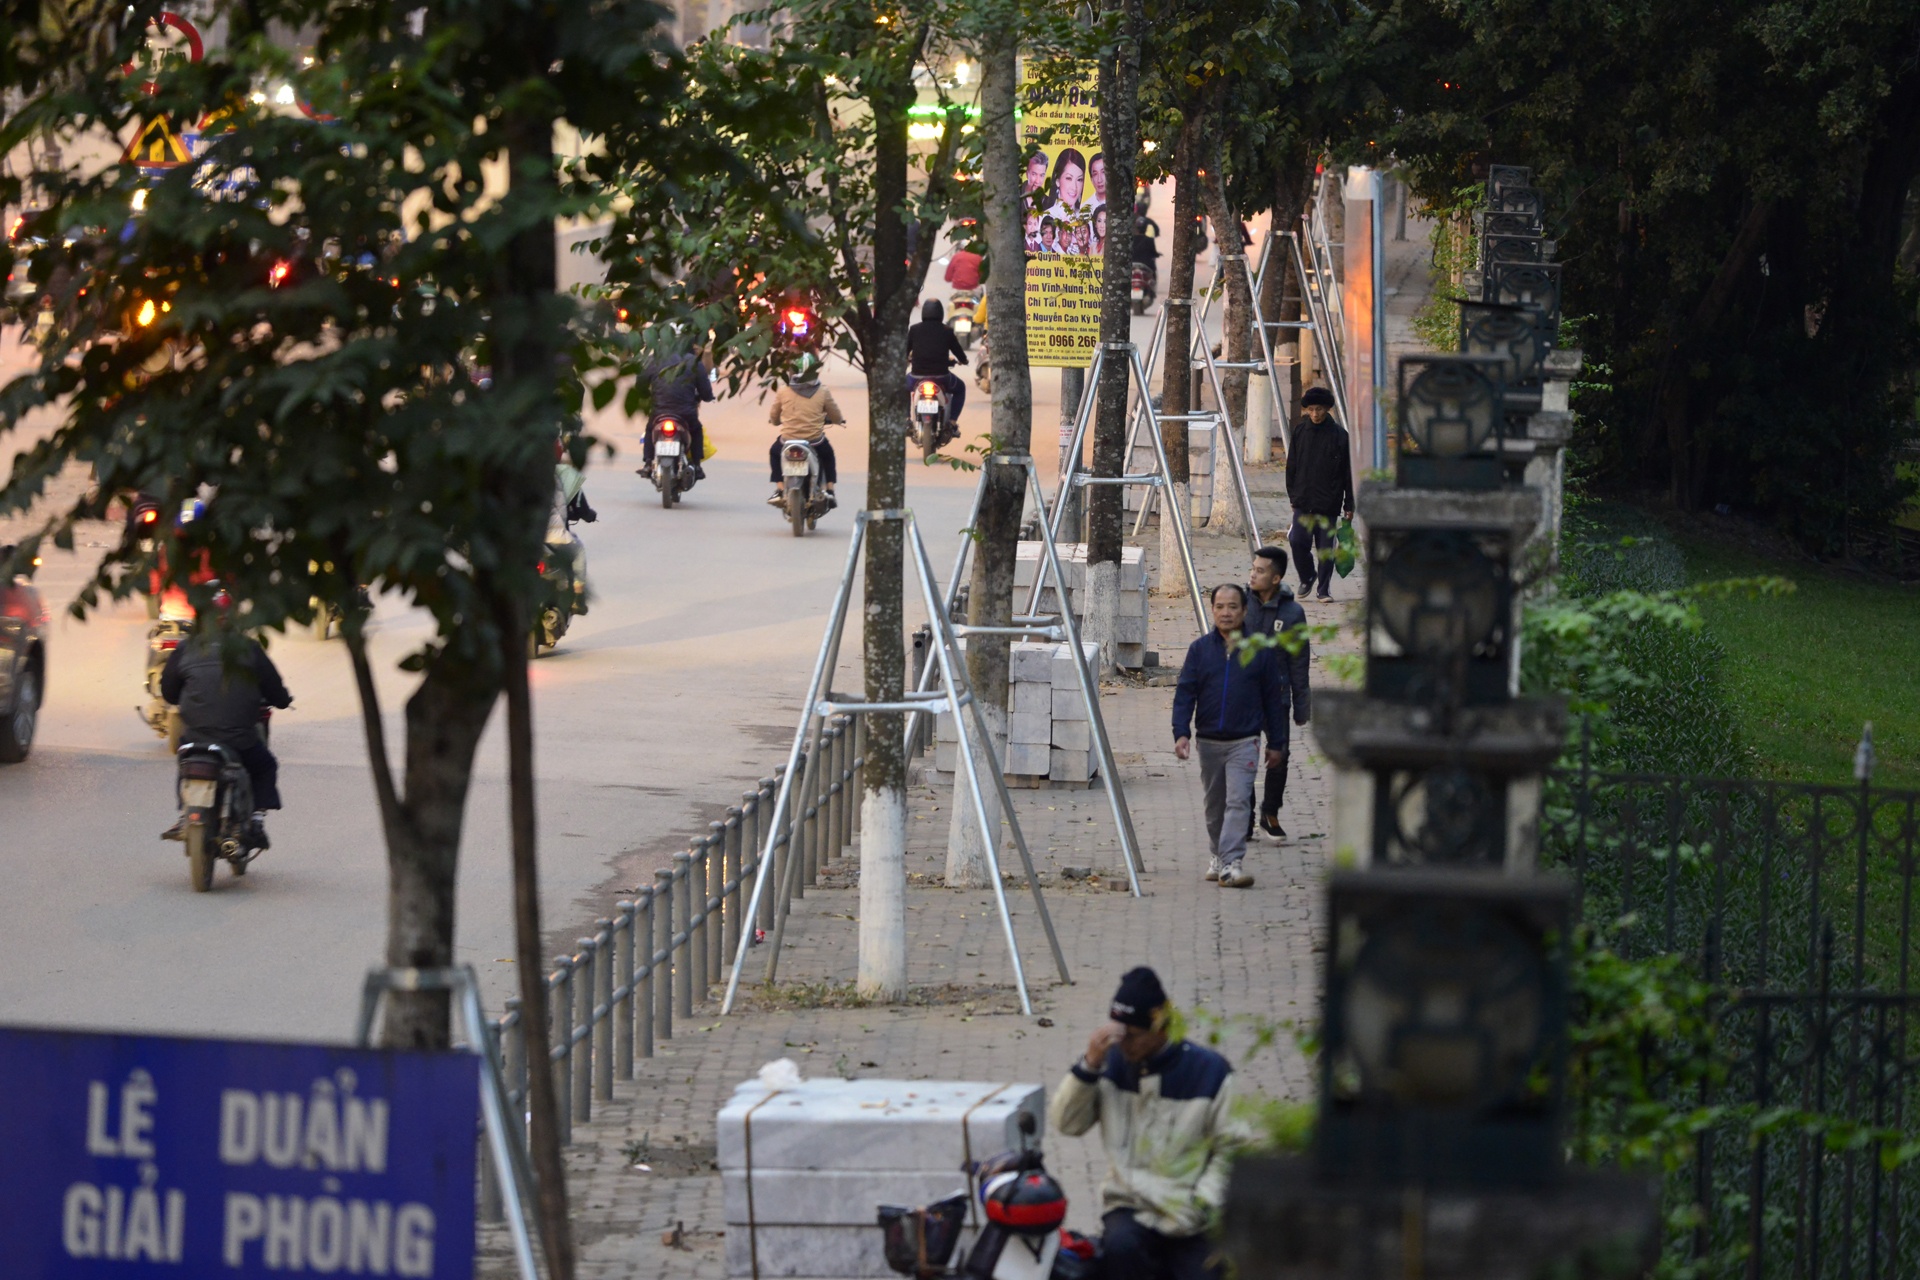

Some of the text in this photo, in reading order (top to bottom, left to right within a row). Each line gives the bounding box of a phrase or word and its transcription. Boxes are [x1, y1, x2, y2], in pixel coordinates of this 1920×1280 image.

[1033, 312, 1062, 322] Nguyễn
[1064, 314, 1078, 322] Cao
[1049, 335, 1074, 347] 0966
[85, 1066, 390, 1174] LÊ DUẨN
[62, 1161, 186, 1264] GIẢI
